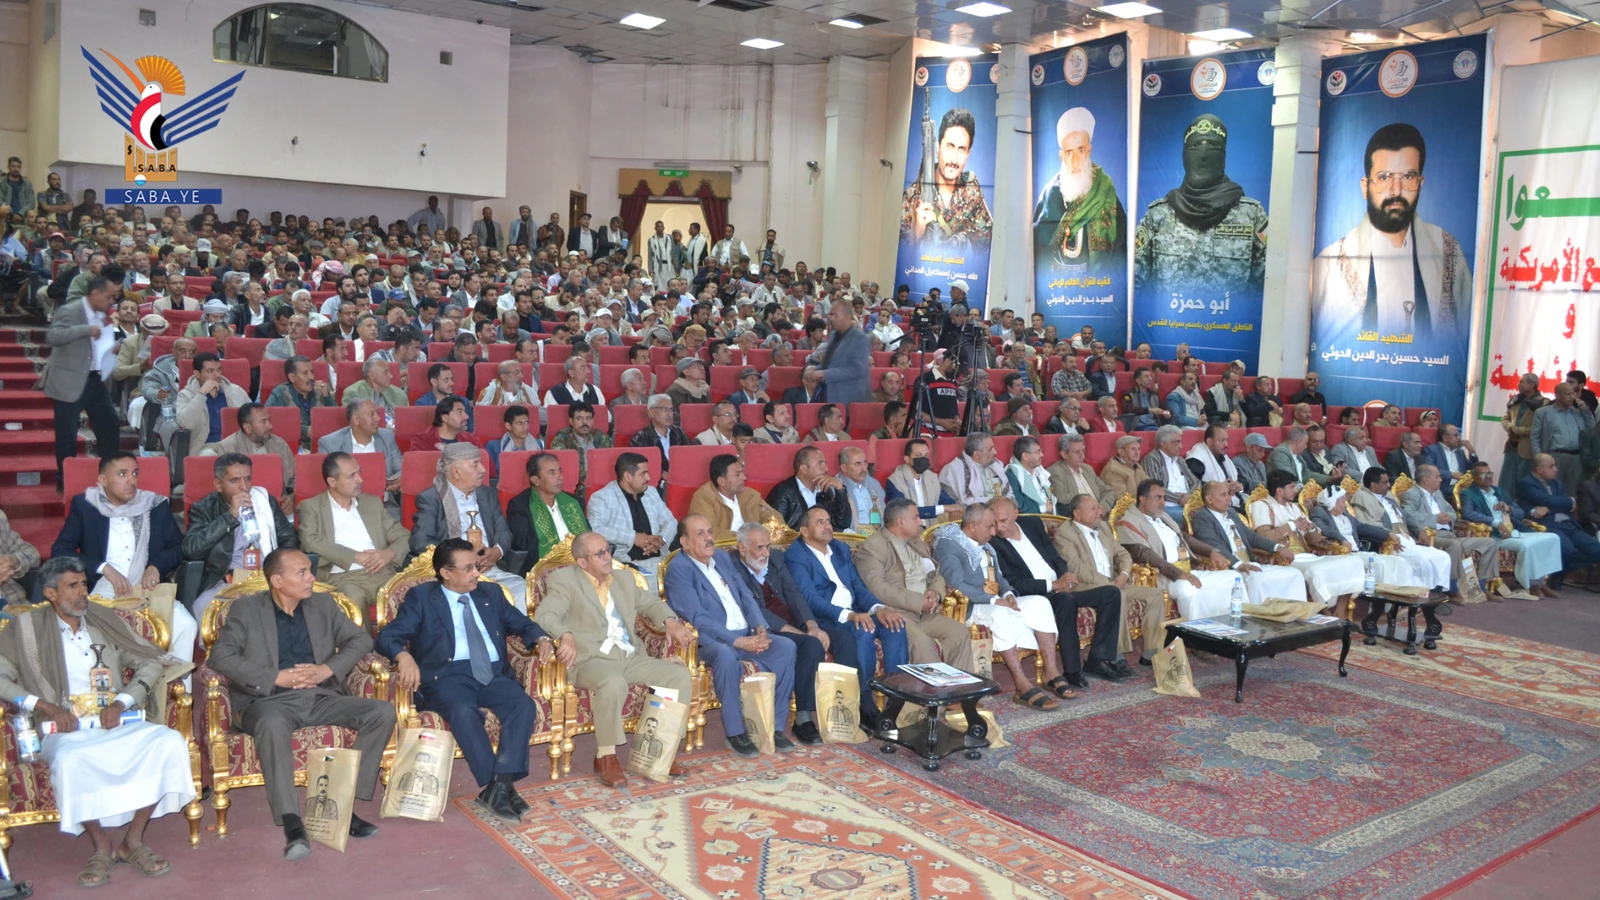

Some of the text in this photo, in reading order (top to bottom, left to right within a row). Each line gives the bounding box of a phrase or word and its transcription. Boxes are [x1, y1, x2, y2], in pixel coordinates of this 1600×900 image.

[925, 267, 950, 279] إسماعيل
[968, 272, 978, 280] طه
[1046, 293, 1113, 306] السيد بدر الدين الحوثي
[1170, 291, 1230, 315] أبو حمزة
[1147, 318, 1253, 332] الناطق العسكري باسم سرايا القدس
[1562, 303, 1576, 339] و
[1356, 329, 1413, 344] الشهيد القائد
[1321, 345, 1351, 361] الحوثي
[1351, 350, 1375, 362] الدين
[1375, 352, 1389, 363] بدر
[1390, 353, 1420, 365] حسين
[1422, 355, 1449, 367] السيد
